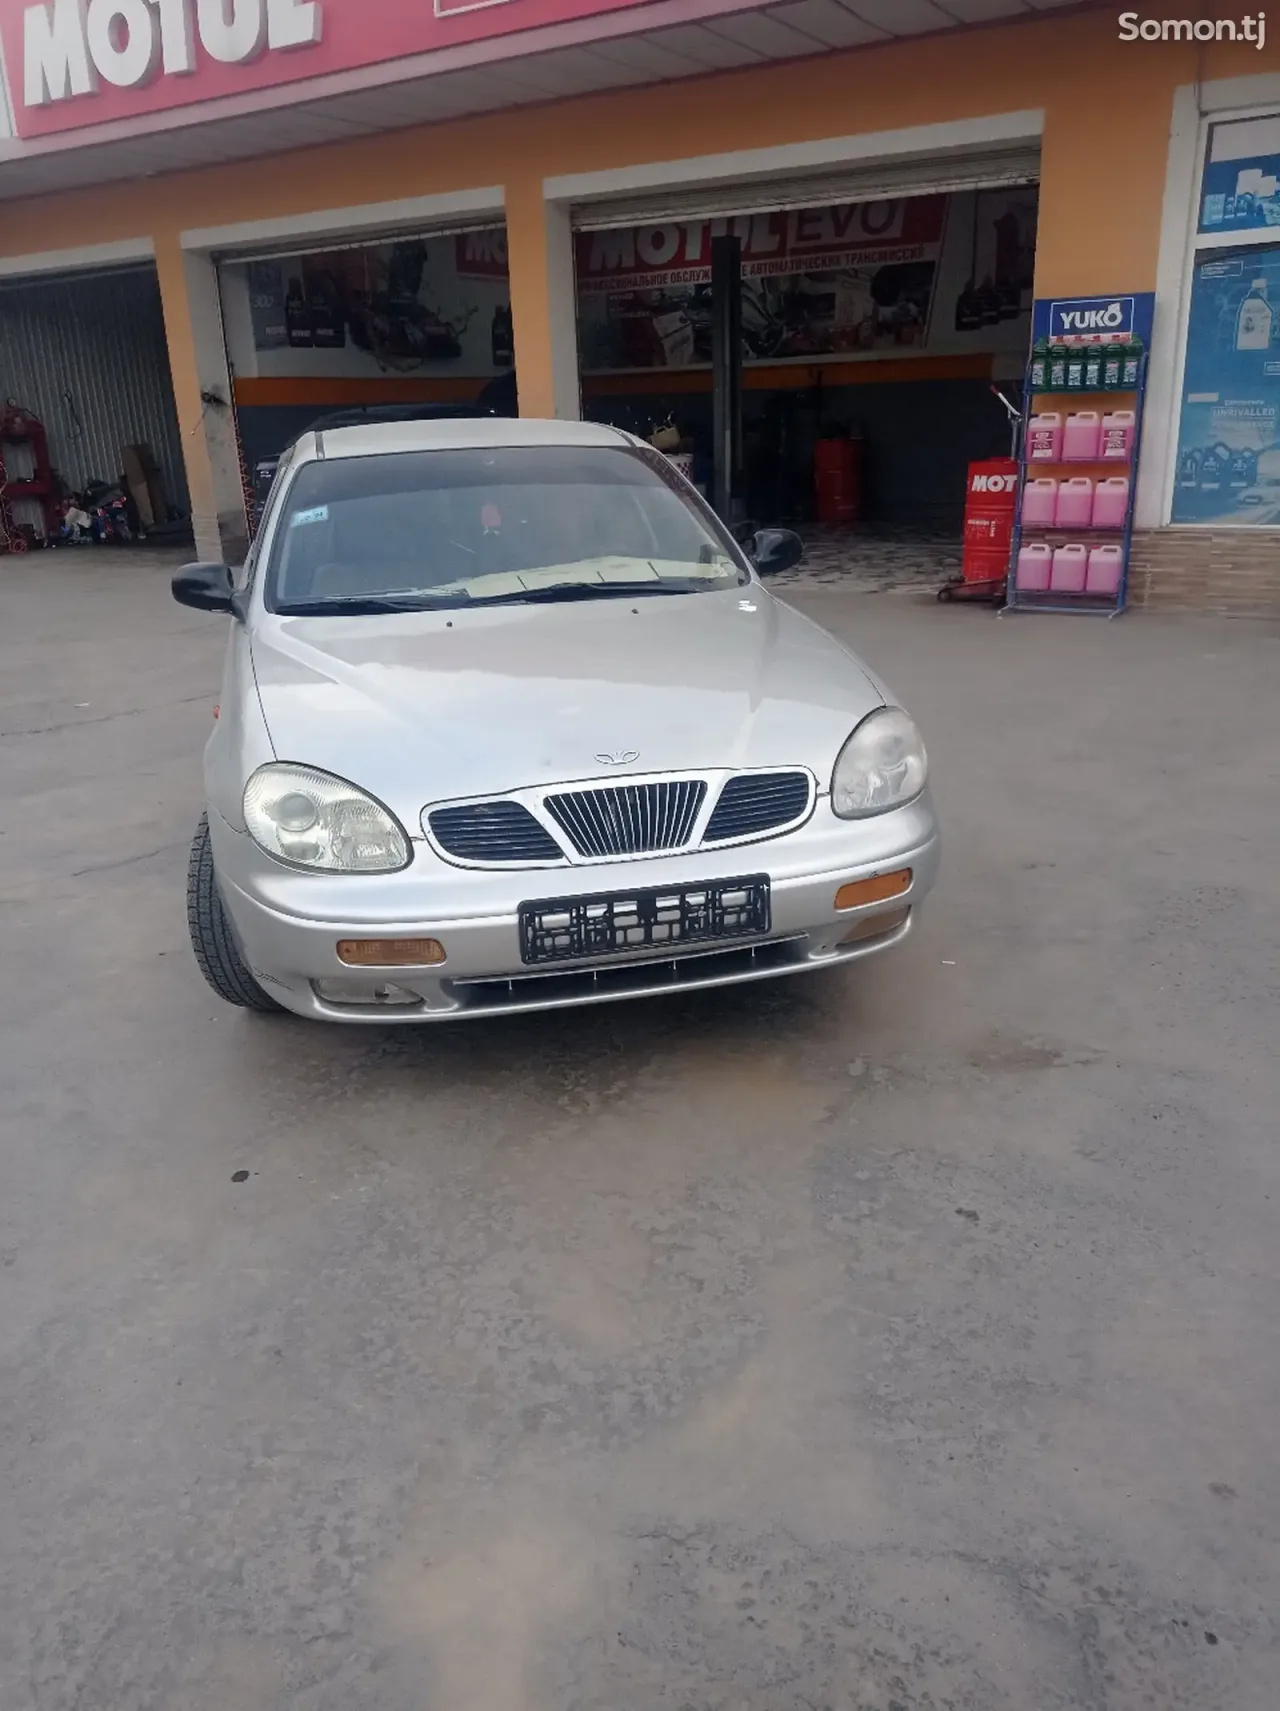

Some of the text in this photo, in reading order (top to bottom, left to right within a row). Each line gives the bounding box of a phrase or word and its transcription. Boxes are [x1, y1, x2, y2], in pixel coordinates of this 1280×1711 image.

[24, 0, 322, 108] MOTUL
[796, 199, 899, 242] EVO
[1060, 302, 1123, 330] YUKO
